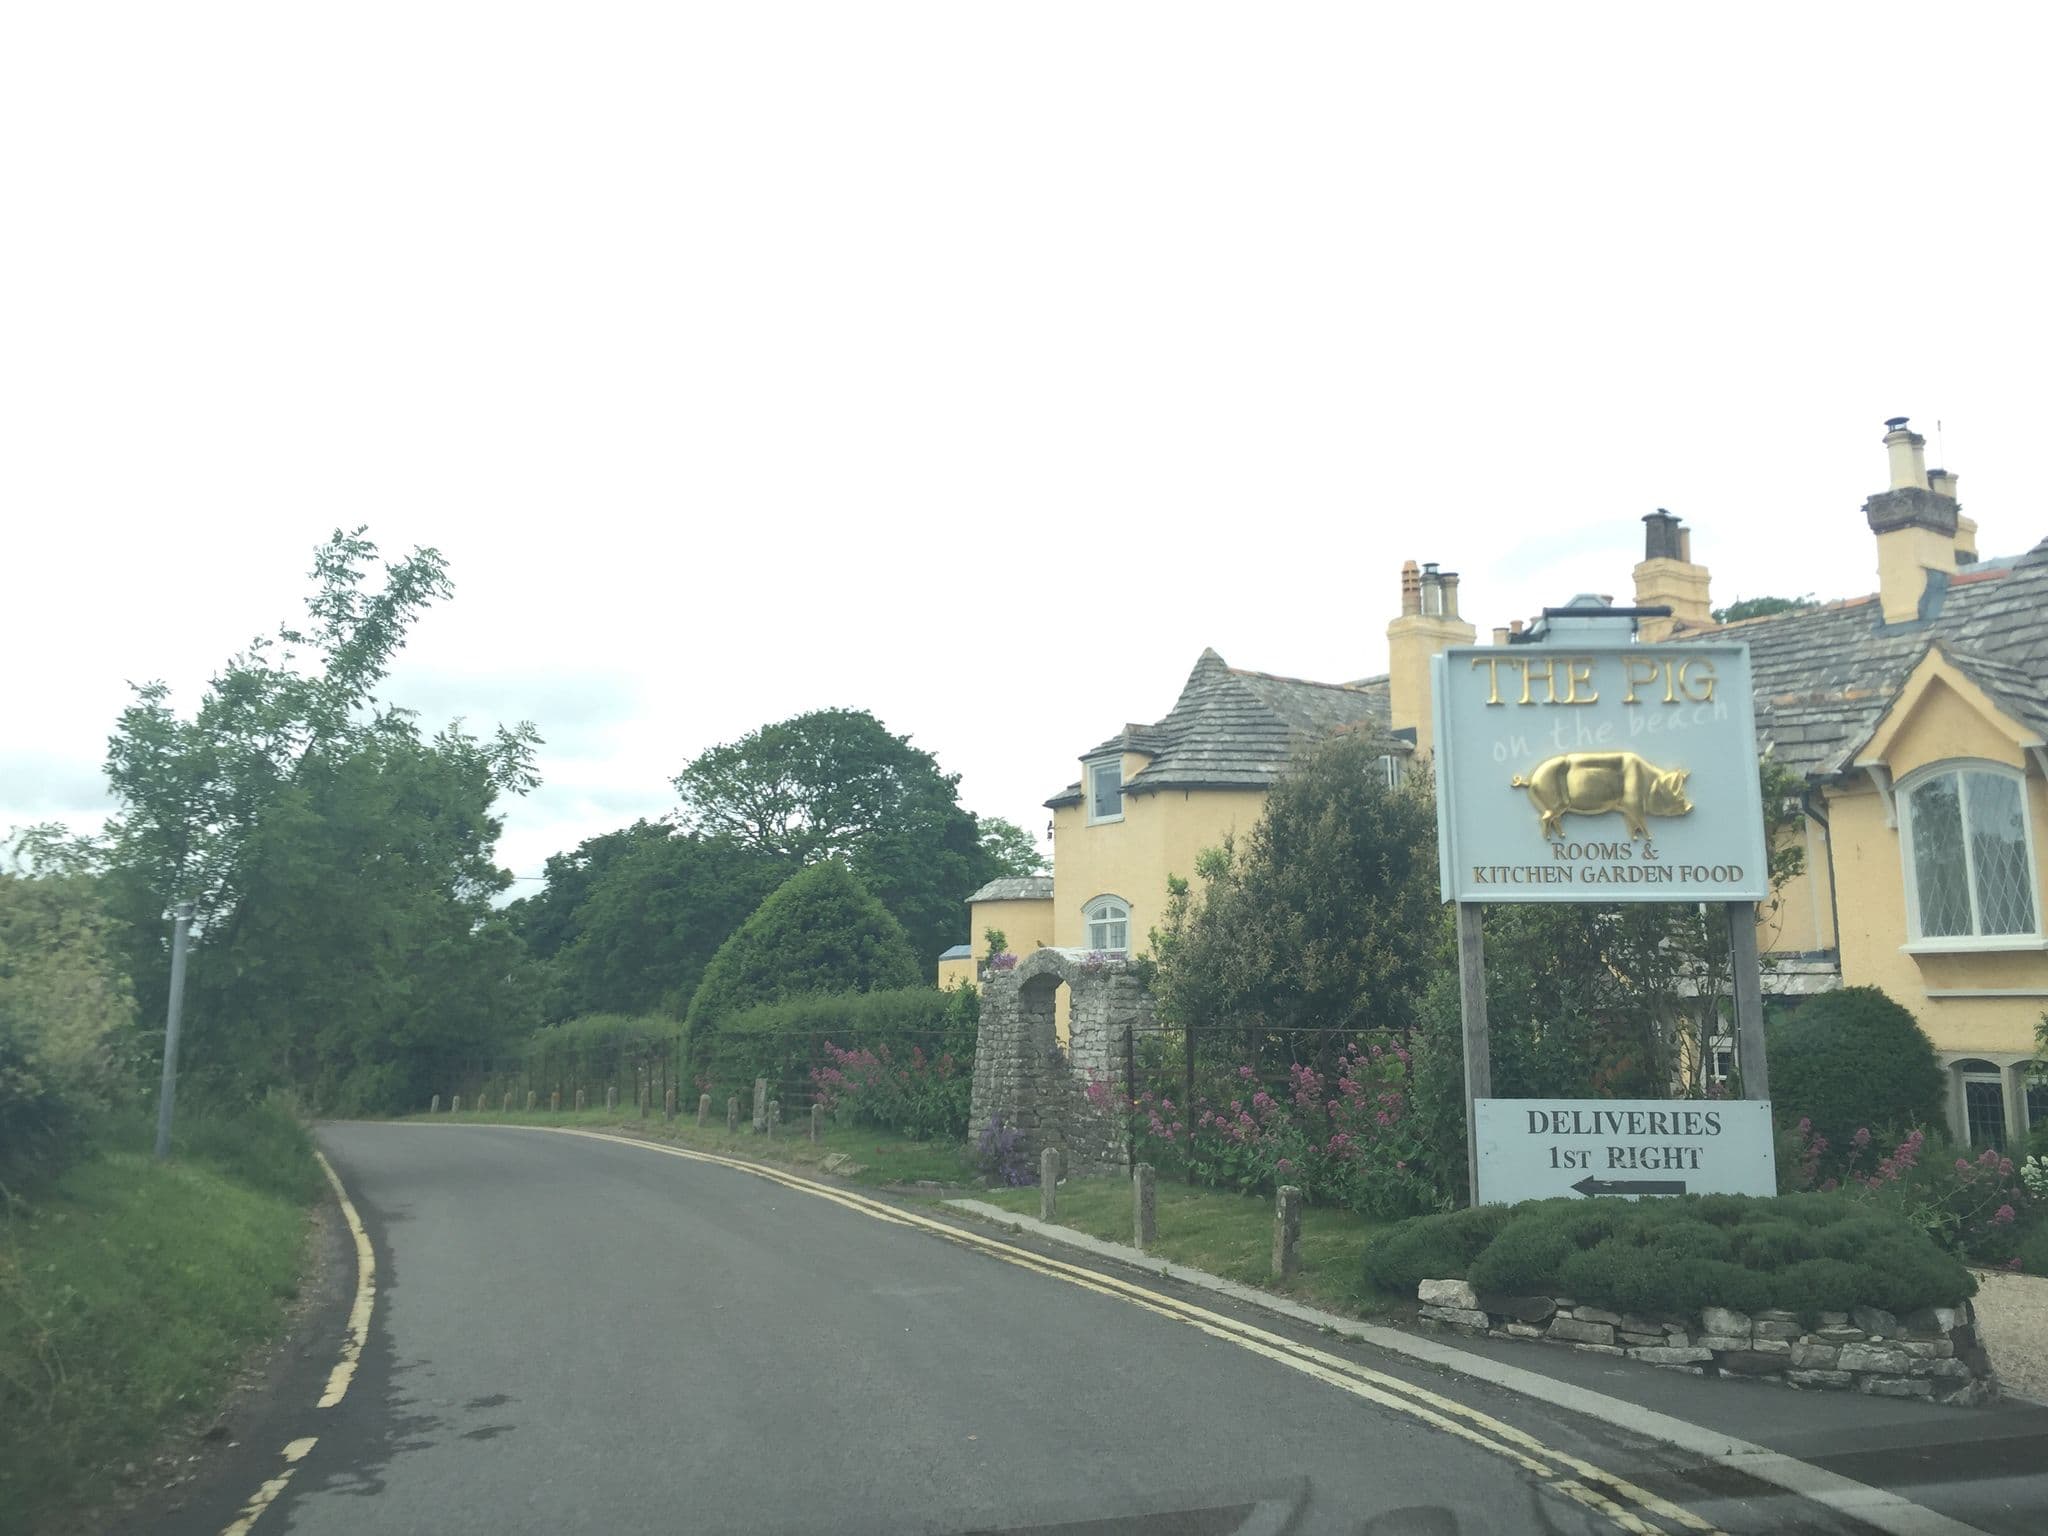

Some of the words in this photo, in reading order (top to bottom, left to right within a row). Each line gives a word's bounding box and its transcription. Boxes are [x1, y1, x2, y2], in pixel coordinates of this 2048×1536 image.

[1472, 657, 1599, 706] THE
[1621, 656, 1718, 706] PIG
[1492, 735, 1531, 762] on
[1550, 709, 1614, 750] the
[1629, 699, 1729, 737] beach
[1551, 842, 1632, 861] ROOMS
[1641, 842, 1660, 861] &
[1472, 865, 1573, 884] KITCHEN
[1579, 865, 1674, 884] GARDEN
[1679, 864, 1744, 883] FOOD
[1527, 1110, 1722, 1136] DELIVERIES
[1606, 1146, 1704, 1170] RIGHT
